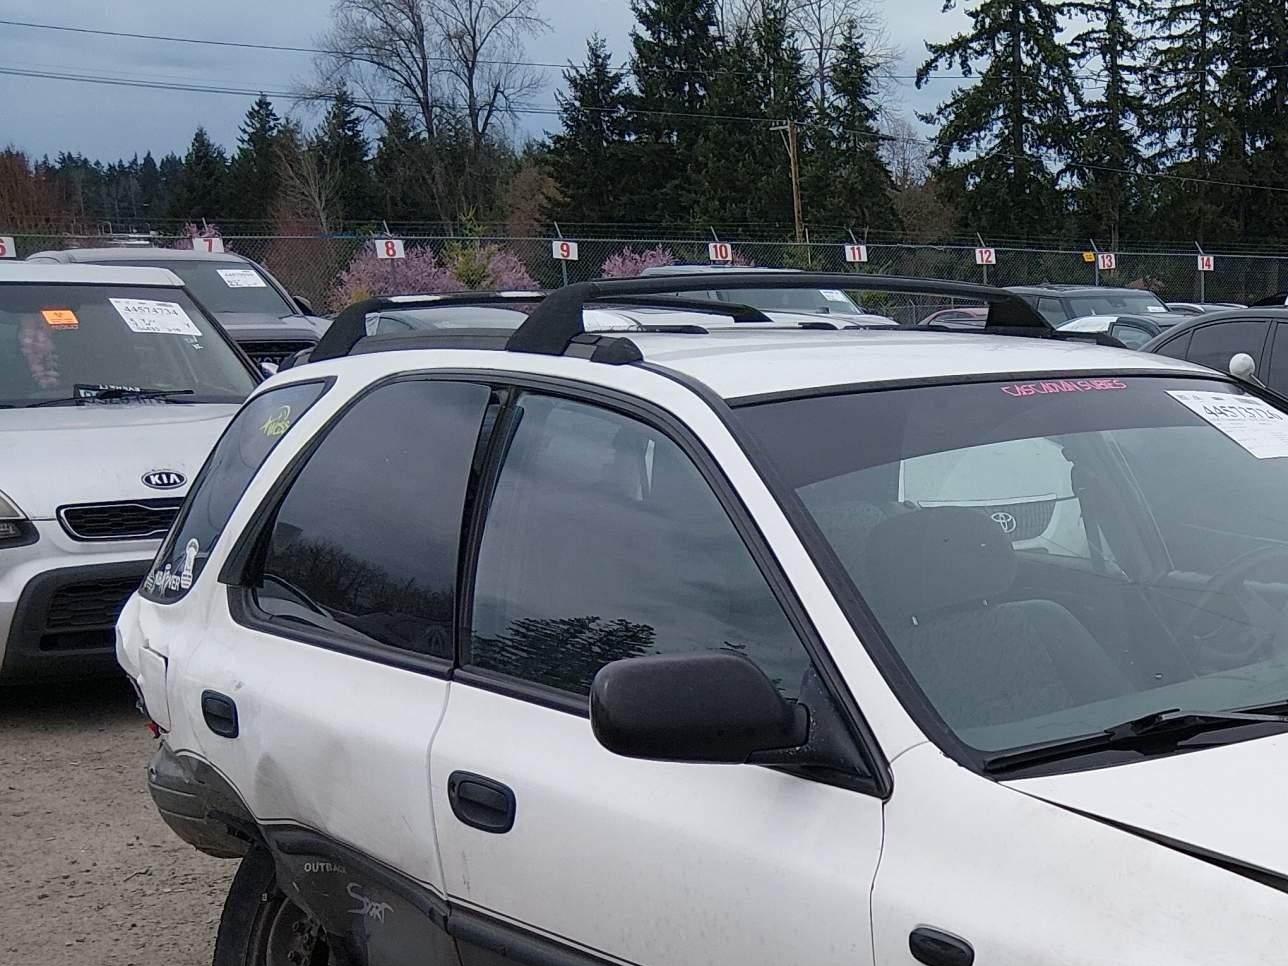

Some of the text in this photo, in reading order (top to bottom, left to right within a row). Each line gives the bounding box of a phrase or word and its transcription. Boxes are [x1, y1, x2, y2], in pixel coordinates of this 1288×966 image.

[384, 240, 396, 257] 8
[560, 242, 570, 258] 9
[713, 244, 729, 259] 10
[851, 246, 862, 261] 11
[979, 249, 993, 263] 12
[1100, 254, 1113, 269] 13
[1200, 256, 1211, 270] 14
[150, 473, 181, 485] KIA
